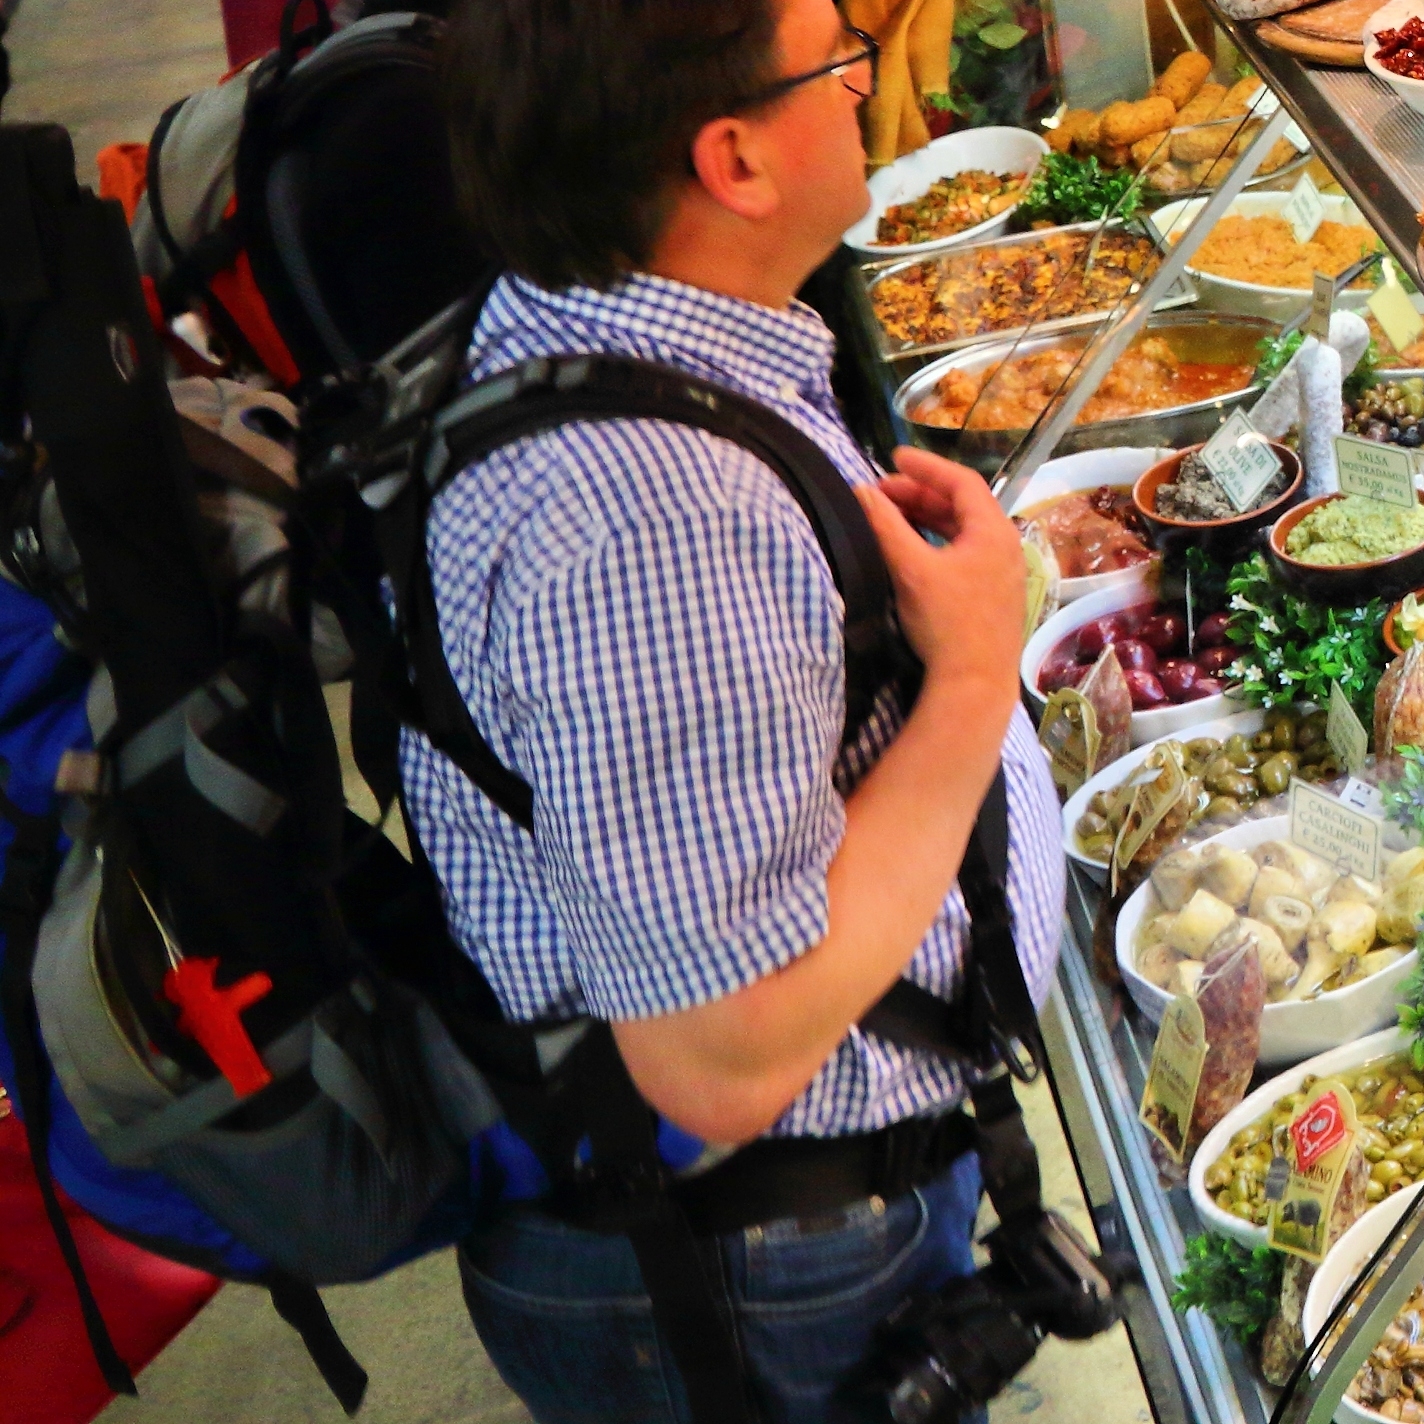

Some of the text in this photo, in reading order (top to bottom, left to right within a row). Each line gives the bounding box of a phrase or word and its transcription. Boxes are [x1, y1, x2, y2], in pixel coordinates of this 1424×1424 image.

[1228, 444, 1252, 477] OLIVE
[1356, 450, 1389, 467] SALSA
[1299, 811, 1370, 855] CASALINGHI
[1308, 800, 1363, 835] CARCIOFI
